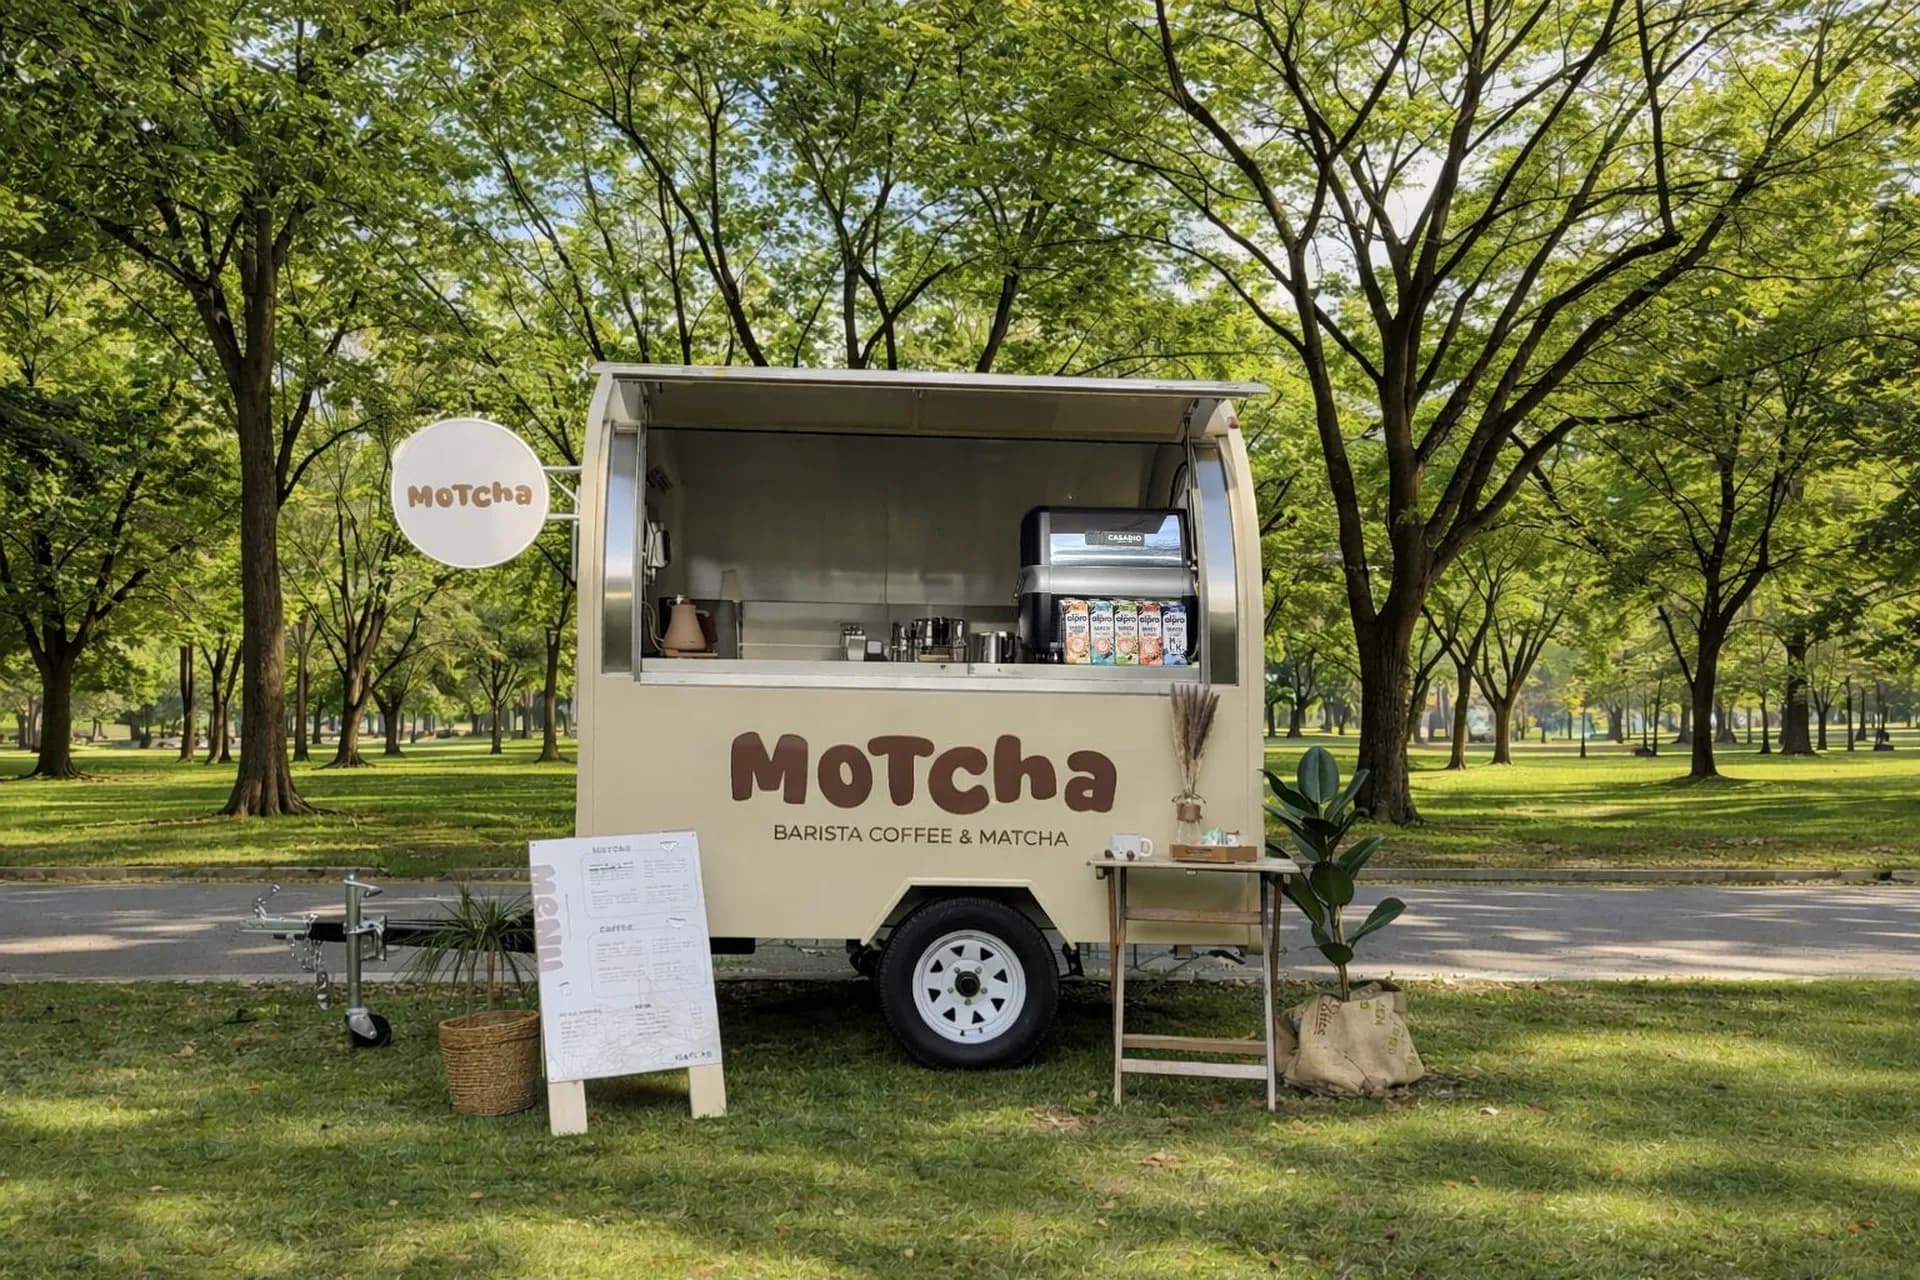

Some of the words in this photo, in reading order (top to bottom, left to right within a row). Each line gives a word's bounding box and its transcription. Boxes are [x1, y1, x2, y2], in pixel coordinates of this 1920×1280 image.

[1108, 534, 1142, 542] CASADIO
[1067, 614, 1087, 623] alpro
[1092, 615, 1112, 623] alpro
[1116, 615, 1136, 624] alpro
[1140, 615, 1160, 624] alpro
[1164, 615, 1185, 625] alpro
[773, 824, 863, 842] BARISTA
[869, 826, 952, 844] COFFEE
[959, 829, 973, 845] &
[979, 830, 1069, 847] MATCHA
